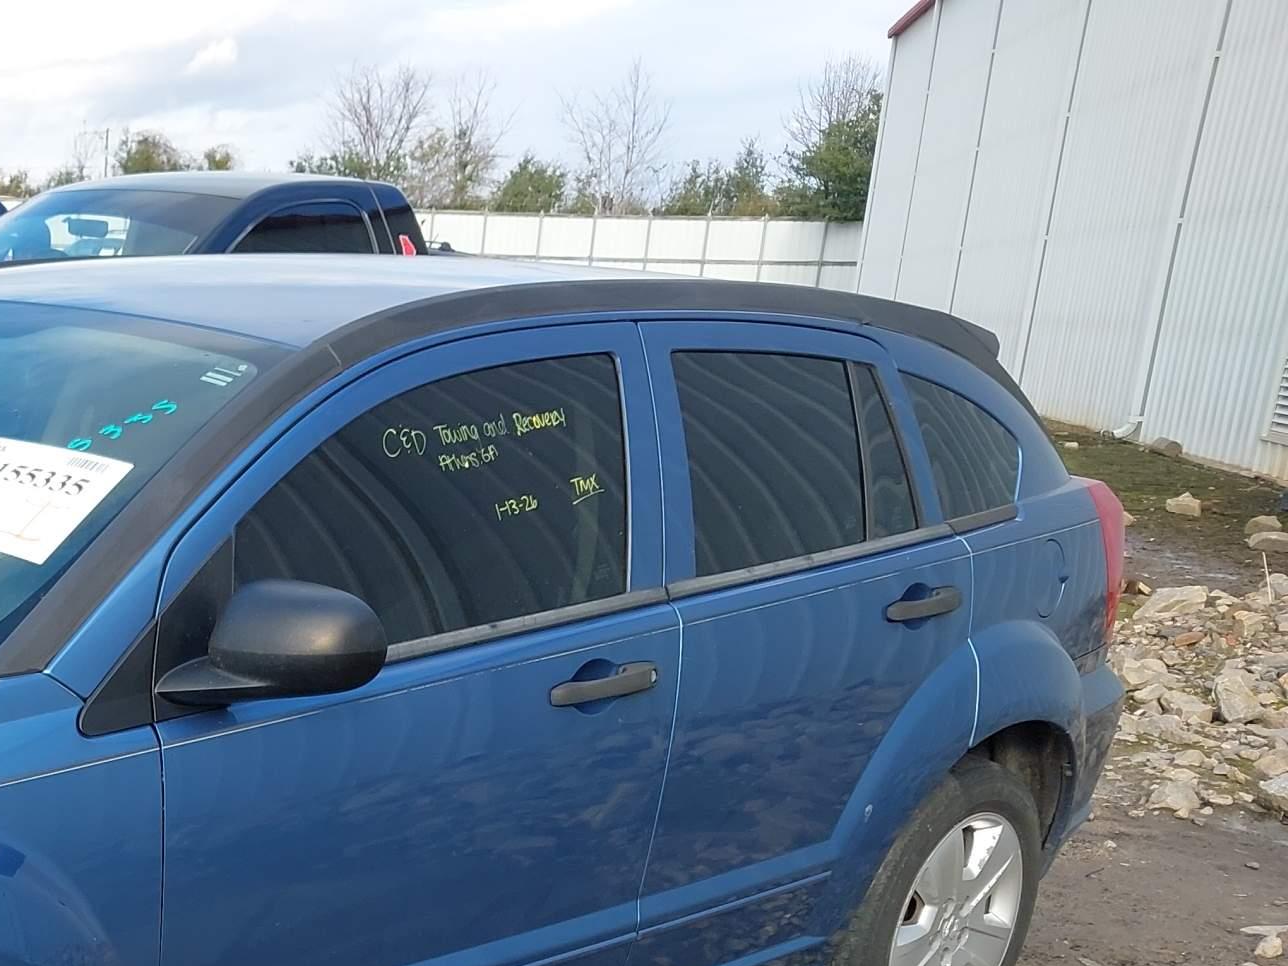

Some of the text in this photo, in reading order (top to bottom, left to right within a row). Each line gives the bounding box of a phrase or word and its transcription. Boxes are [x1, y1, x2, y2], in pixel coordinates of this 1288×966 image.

[433, 423, 482, 447] Towing
[483, 413, 509, 437] and
[512, 408, 567, 436] Recovery
[495, 495, 538, 520] 1-13-26
